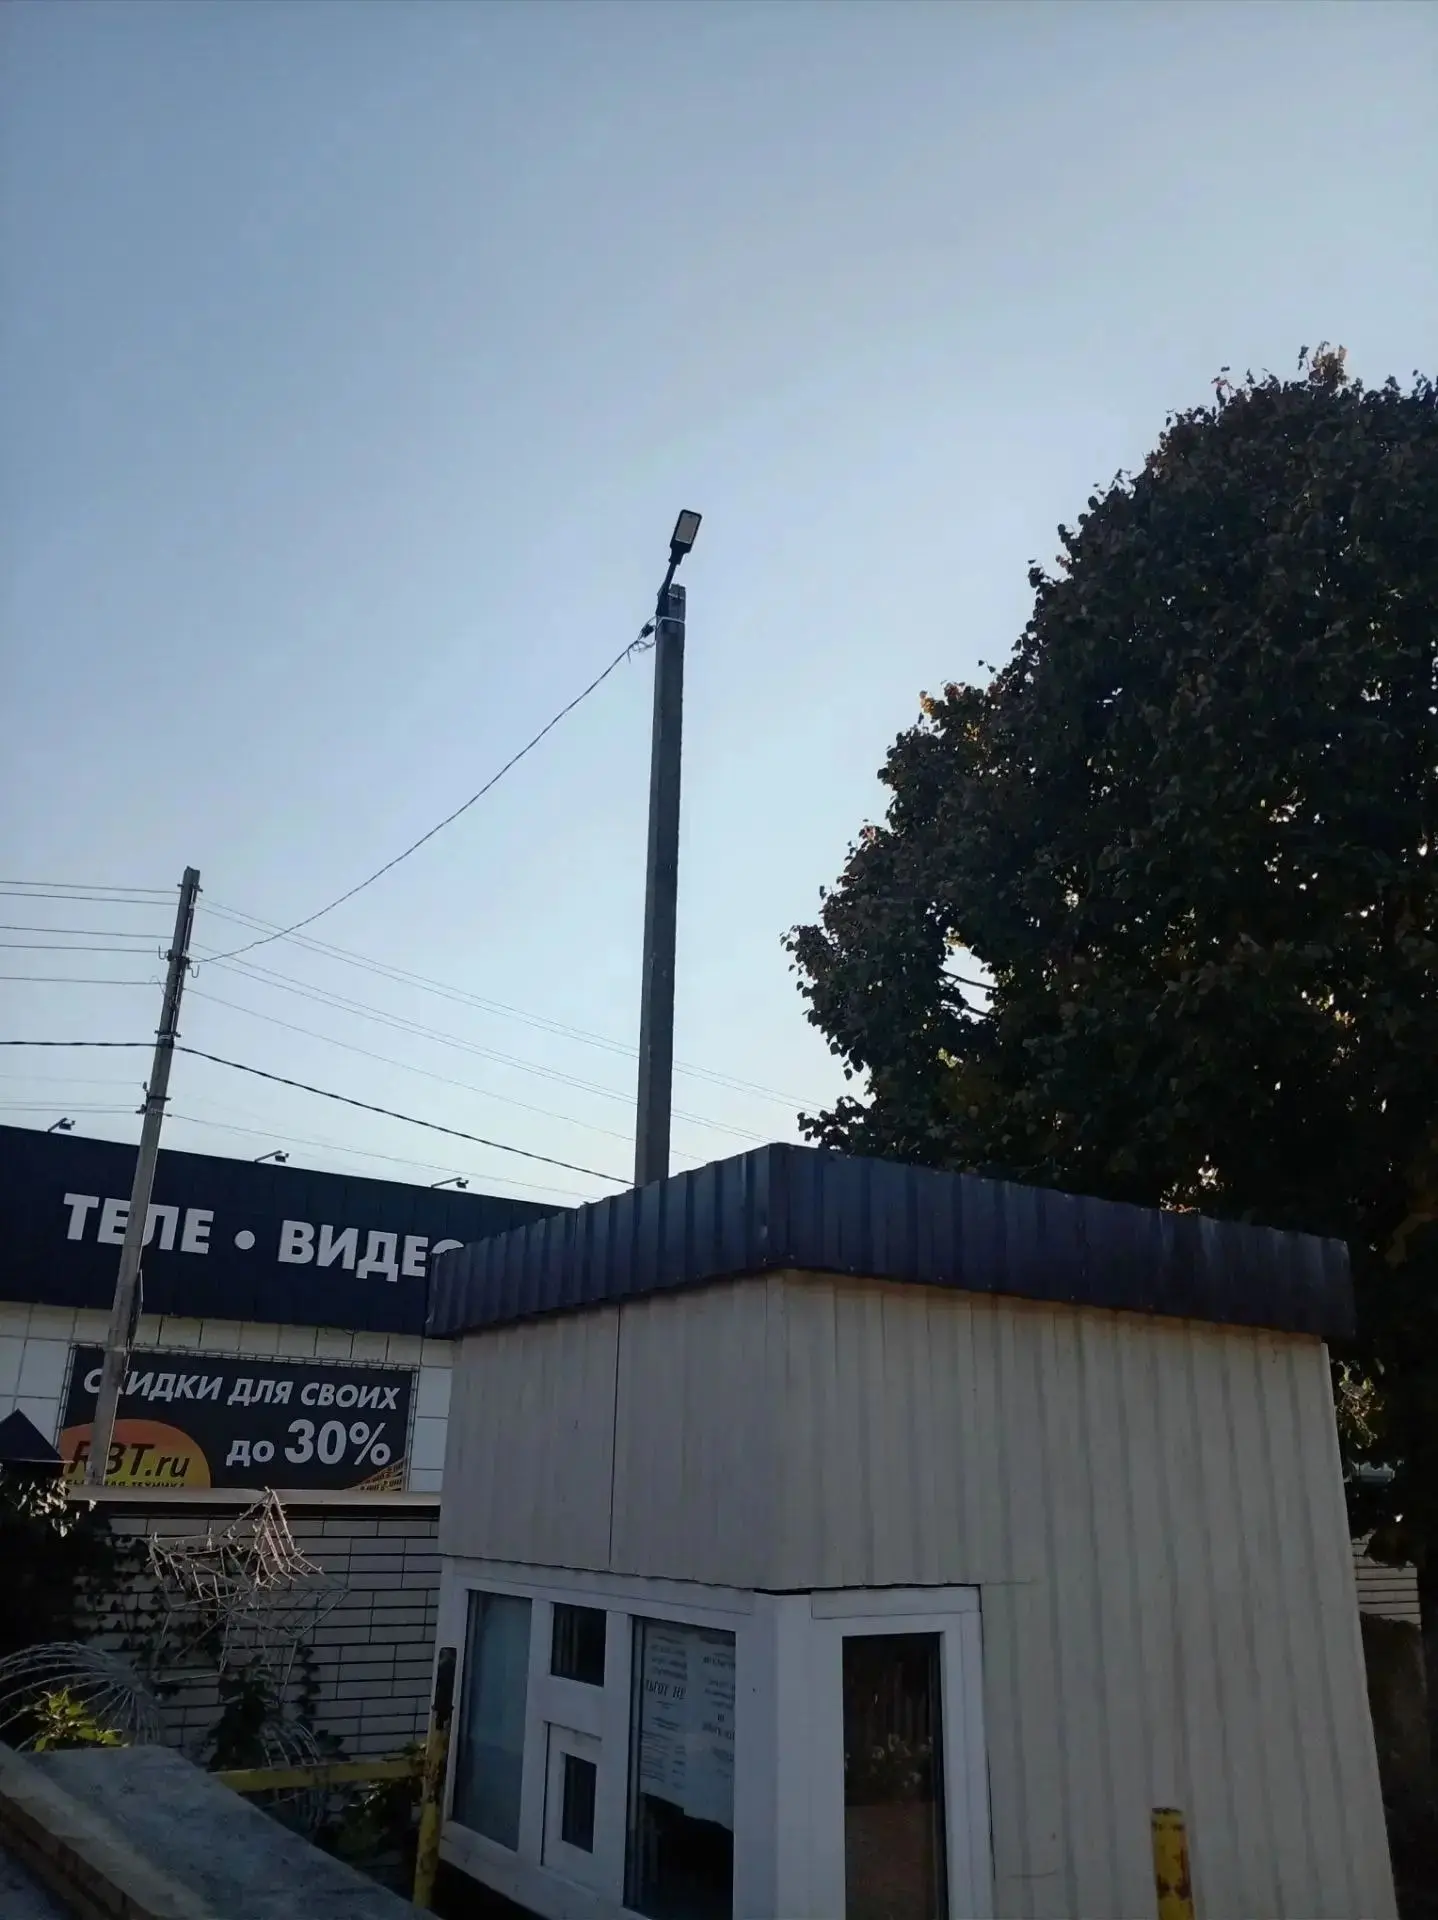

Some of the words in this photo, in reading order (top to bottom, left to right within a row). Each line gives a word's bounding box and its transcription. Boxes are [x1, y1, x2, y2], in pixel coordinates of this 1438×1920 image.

[64, 1193, 214, 1254] ТЕЛЕ
[278, 1220, 464, 1282] ВИДЕ
[84, 1368, 223, 1402] СИДКИ
[227, 1378, 293, 1406] ДЛЯ
[301, 1382, 400, 1409] СВОИХ
[285, 1419, 391, 1466] 30%
